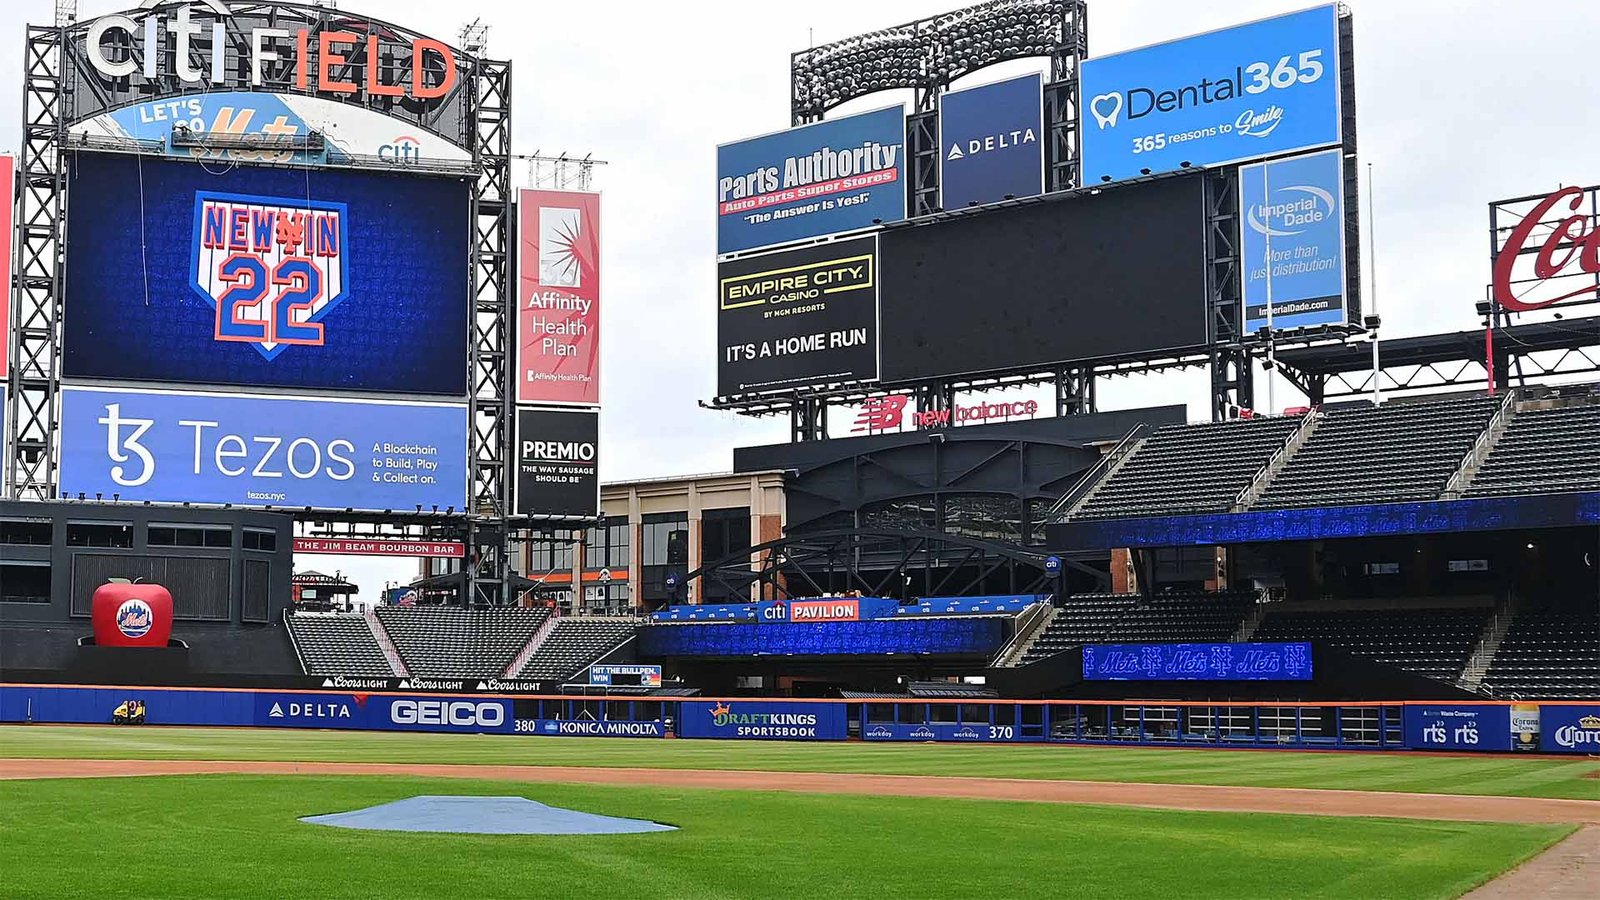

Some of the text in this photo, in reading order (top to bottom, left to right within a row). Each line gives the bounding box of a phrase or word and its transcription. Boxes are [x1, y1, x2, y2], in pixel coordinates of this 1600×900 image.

[252, 26, 456, 98] FIELD
[140, 99, 202, 123] LET'S
[1132, 105, 1284, 154] 365 reasons to Smile
[969, 128, 1036, 154] DELTA
[378, 141, 419, 164] citi
[720, 142, 898, 202] Parts Authority
[725, 173, 892, 212] Auto Parts Super Stores
[774, 203, 819, 219] Answer
[823, 199, 834, 211] Is
[1259, 196, 1317, 218] Imperial
[1284, 210, 1323, 226] Dade
[204, 206, 275, 252] NEW
[304, 214, 338, 257] IN
[1263, 246, 1318, 263] More than
[1250, 254, 1337, 283] jus distribution!
[729, 275, 808, 299] EMPIRE
[214, 252, 324, 346] 22
[529, 292, 592, 316] Affinity
[770, 289, 819, 304] CASINO
[764, 303, 825, 318] BY MGM RESORTS
[532, 316, 587, 335] Health
[543, 338, 577, 356] Plan
[726, 328, 866, 362] IT'S A HOME RUN
[535, 373, 592, 382] Affinity Health Plan
[912, 400, 1038, 426] new balance
[179, 420, 355, 480] Tezos
[373, 442, 437, 455] A Blockchain
[522, 441, 594, 460] PREMIO
[373, 458, 437, 471] to Build, Play
[522, 465, 537, 473] THE
[558, 467, 594, 475] SAUSAGE
[372, 472, 436, 483] & Collect on.
[247, 491, 285, 501] tezos.nyc
[297, 541, 455, 554] THE JIM BEAM BOURBON BAR
[764, 604, 785, 619] citi
[794, 606, 854, 618] PAVILION
[1100, 650, 1139, 673] Mets
[1165, 650, 1207, 673] Mets
[1236, 650, 1280, 673] Mets
[334, 675, 388, 688] Coors LIGHT
[409, 676, 463, 690] Coors LIGHT
[487, 678, 541, 691] Coors LIGHT
[593, 674, 608, 682] WIN
[290, 703, 350, 718] DELTA
[390, 699, 504, 727] GEICO
[514, 720, 535, 732] 380
[559, 722, 658, 735] KONICA MINOLTA
[713, 713, 817, 727] DRAFTKINGS
[1512, 717, 1538, 727] Corona
[737, 726, 815, 737] SPORTSBOOK
[866, 730, 892, 738] workday
[954, 731, 979, 739] workday
[989, 726, 1013, 739] 370
[1423, 723, 1446, 743] rts
[1454, 724, 1478, 744] rts
